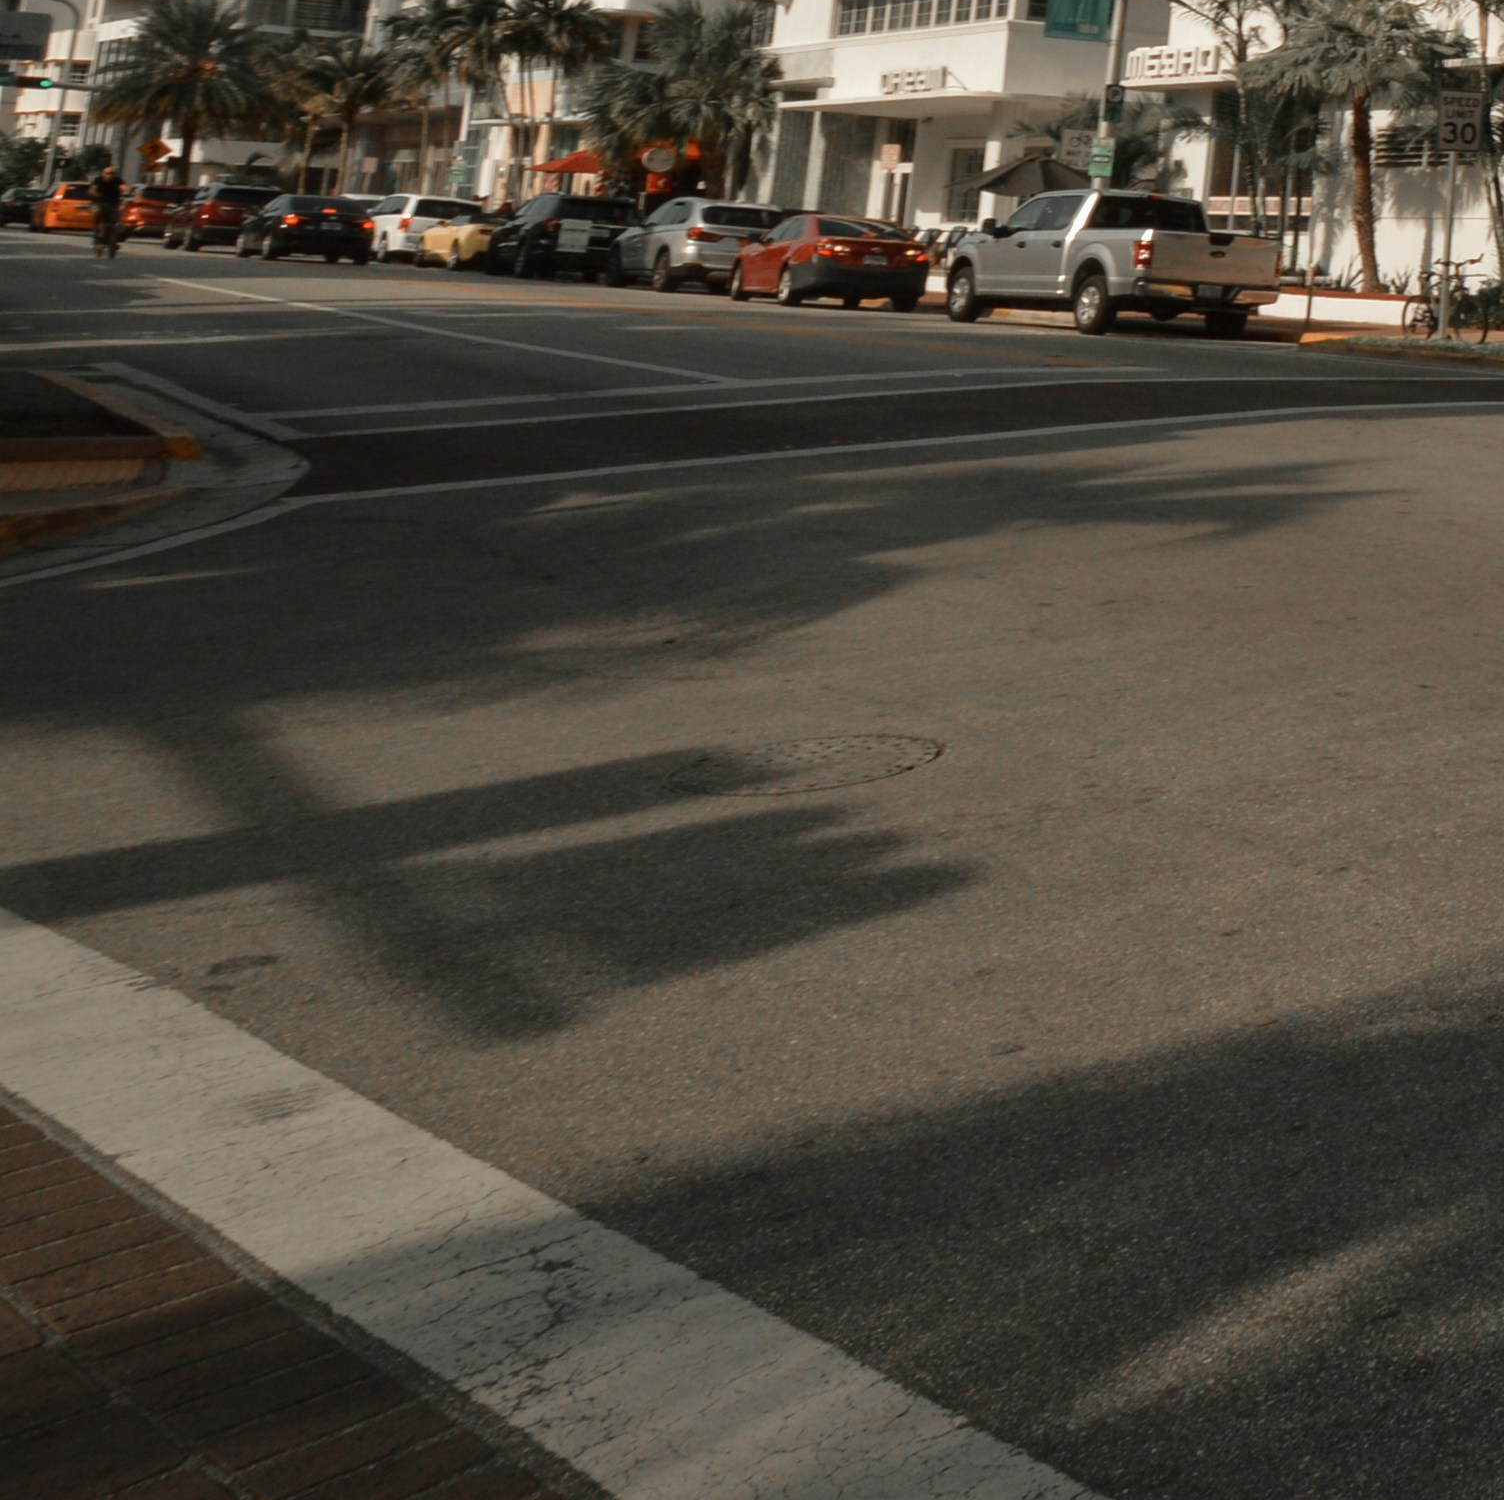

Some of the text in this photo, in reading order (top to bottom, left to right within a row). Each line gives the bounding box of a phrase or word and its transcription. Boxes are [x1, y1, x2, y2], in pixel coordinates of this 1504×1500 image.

[1442, 96, 1480, 107] SPEED
[1445, 109, 1475, 119] LIMIT
[1442, 121, 1477, 144] 30
